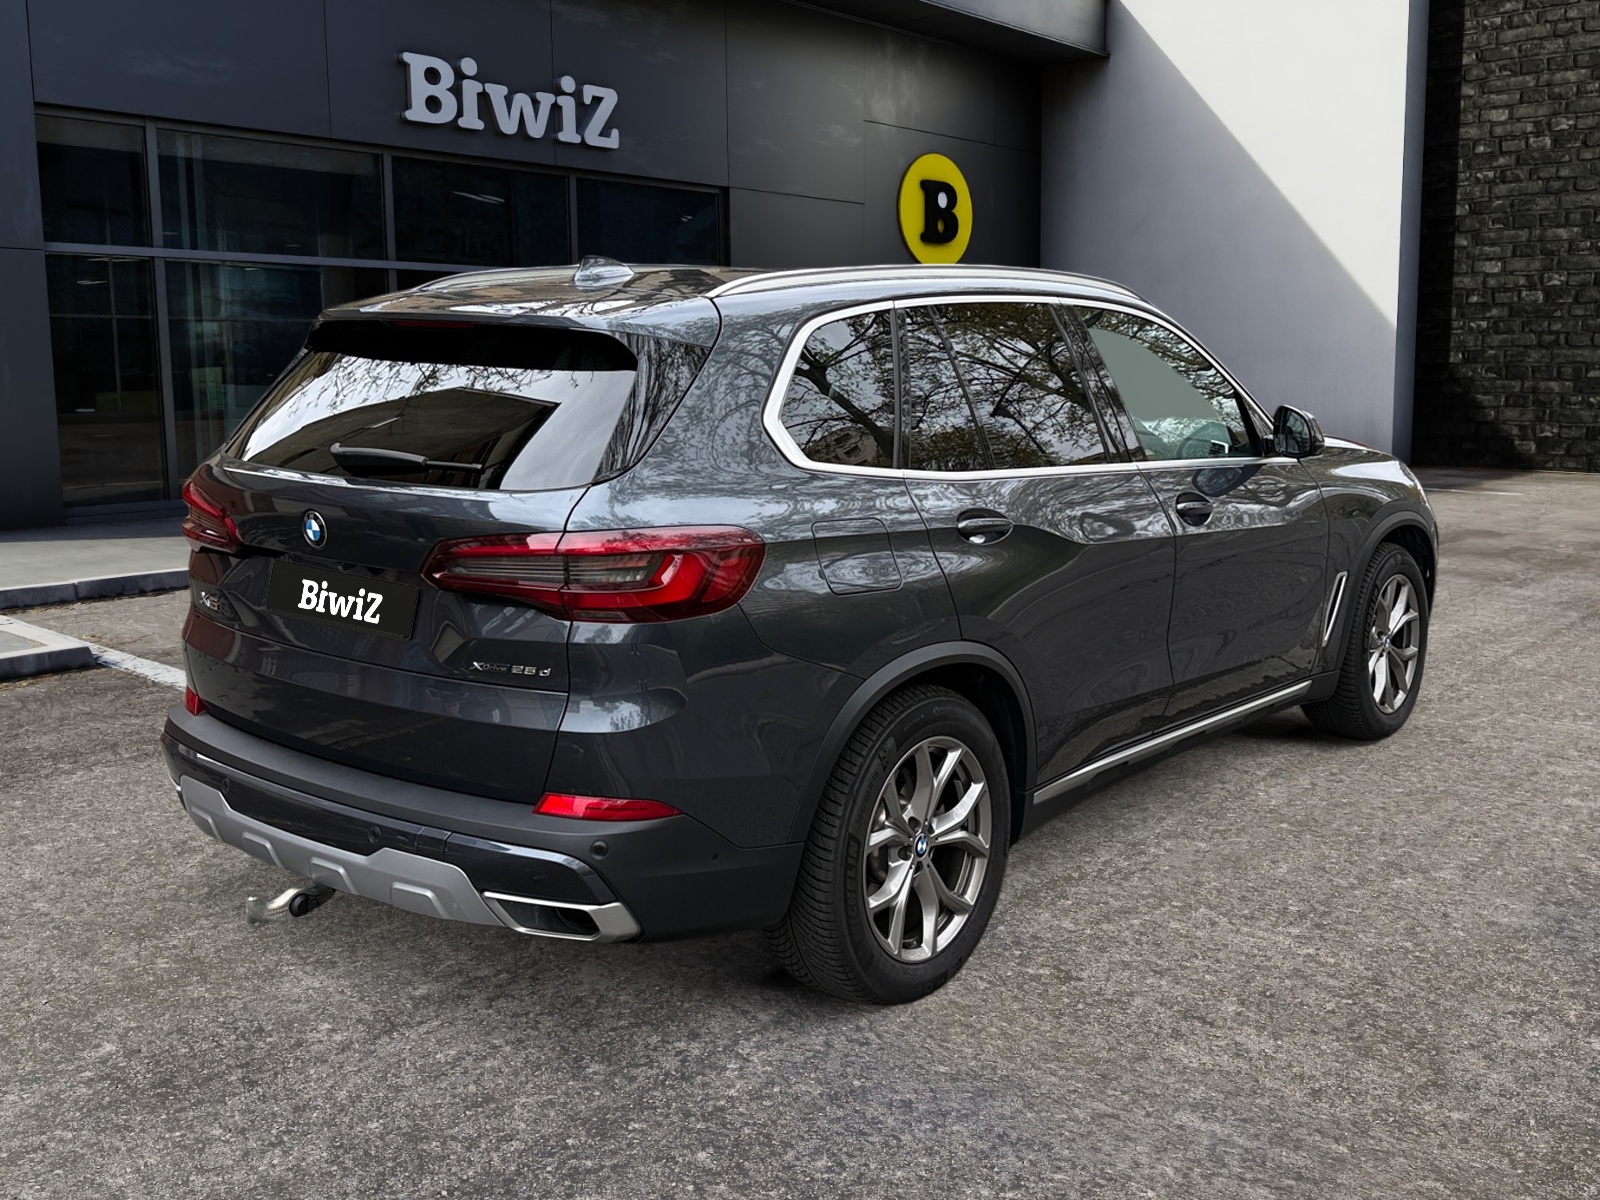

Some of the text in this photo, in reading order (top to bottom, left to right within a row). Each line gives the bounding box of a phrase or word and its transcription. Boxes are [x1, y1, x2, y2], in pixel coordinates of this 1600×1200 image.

[400, 52, 620, 149] BiwiZ
[920, 179, 959, 244] B
[298, 579, 383, 624] BiwiZ
